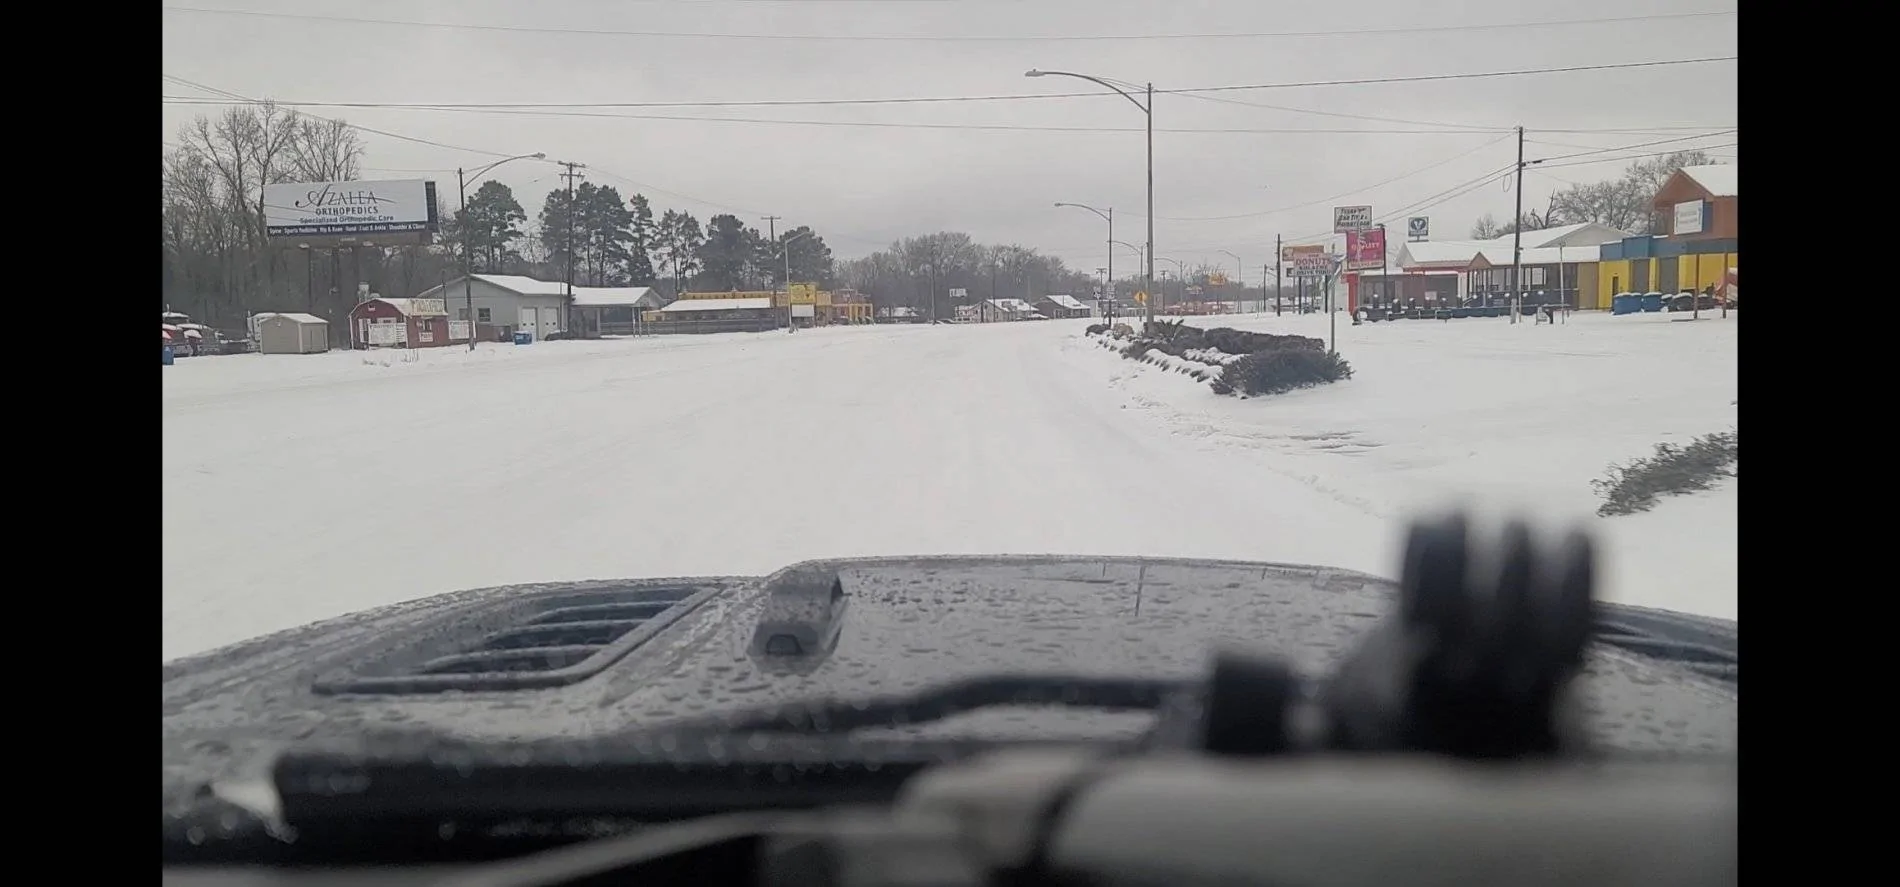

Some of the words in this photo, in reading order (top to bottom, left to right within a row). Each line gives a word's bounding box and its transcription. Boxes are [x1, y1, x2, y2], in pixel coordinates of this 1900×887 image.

[295, 183, 380, 208] AZALEA
[315, 206, 379, 216] ORTHOPEDICS
[1295, 257, 1332, 266] DONUTS
